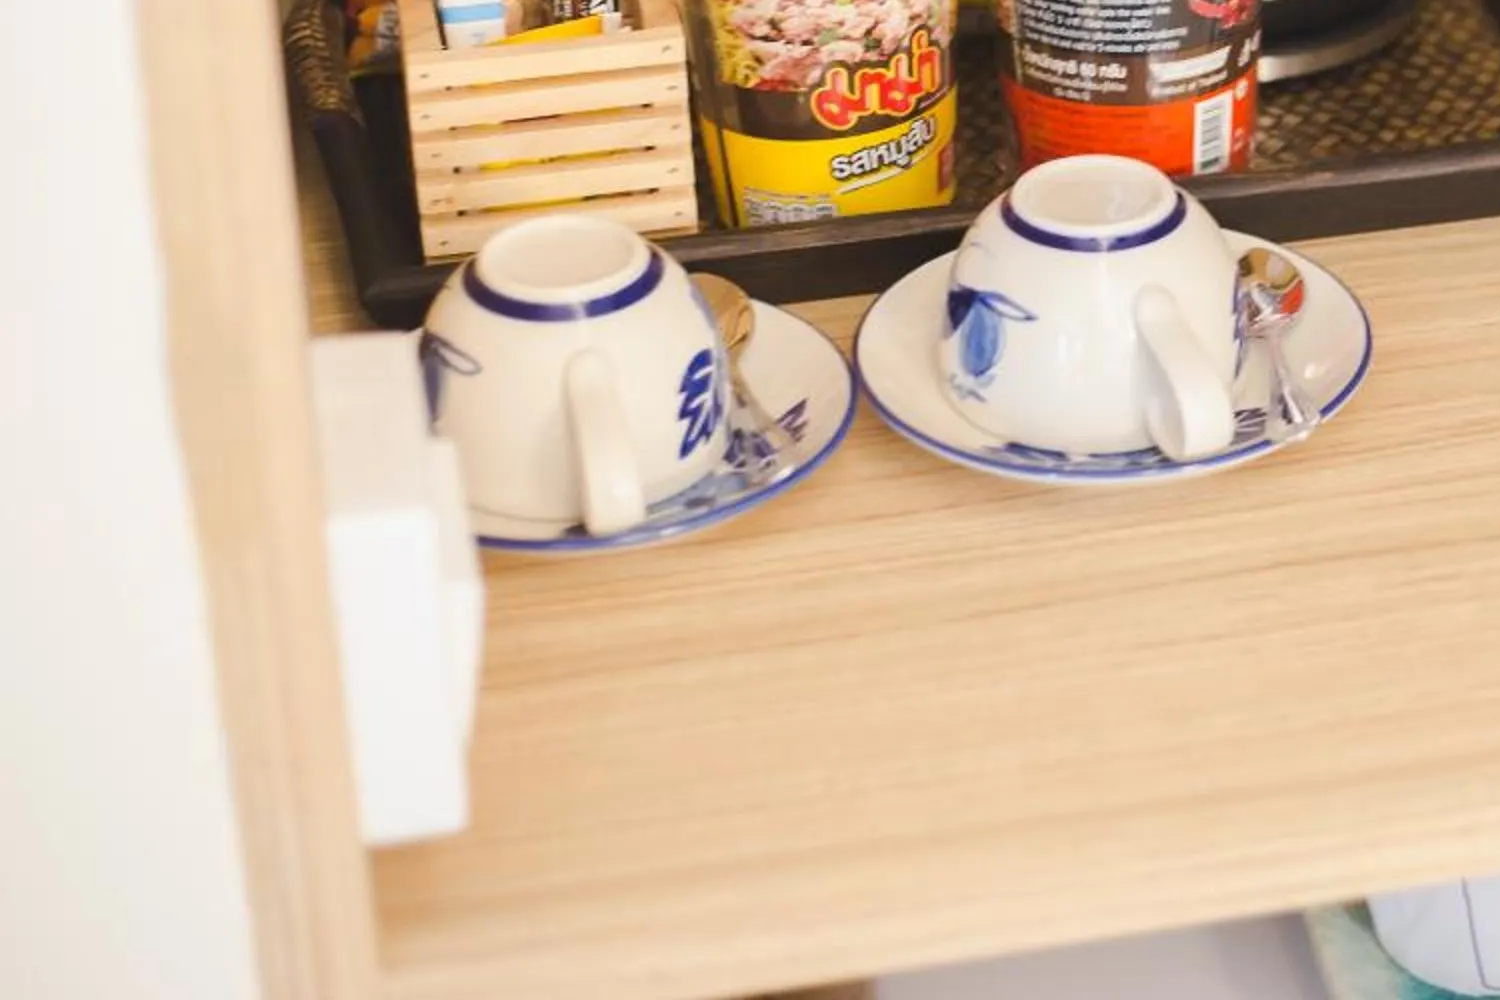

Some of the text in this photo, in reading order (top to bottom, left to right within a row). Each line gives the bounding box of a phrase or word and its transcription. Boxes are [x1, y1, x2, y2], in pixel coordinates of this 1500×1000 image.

[811, 30, 941, 130] มาม่า
[831, 115, 936, 180] รสหมูสับ
